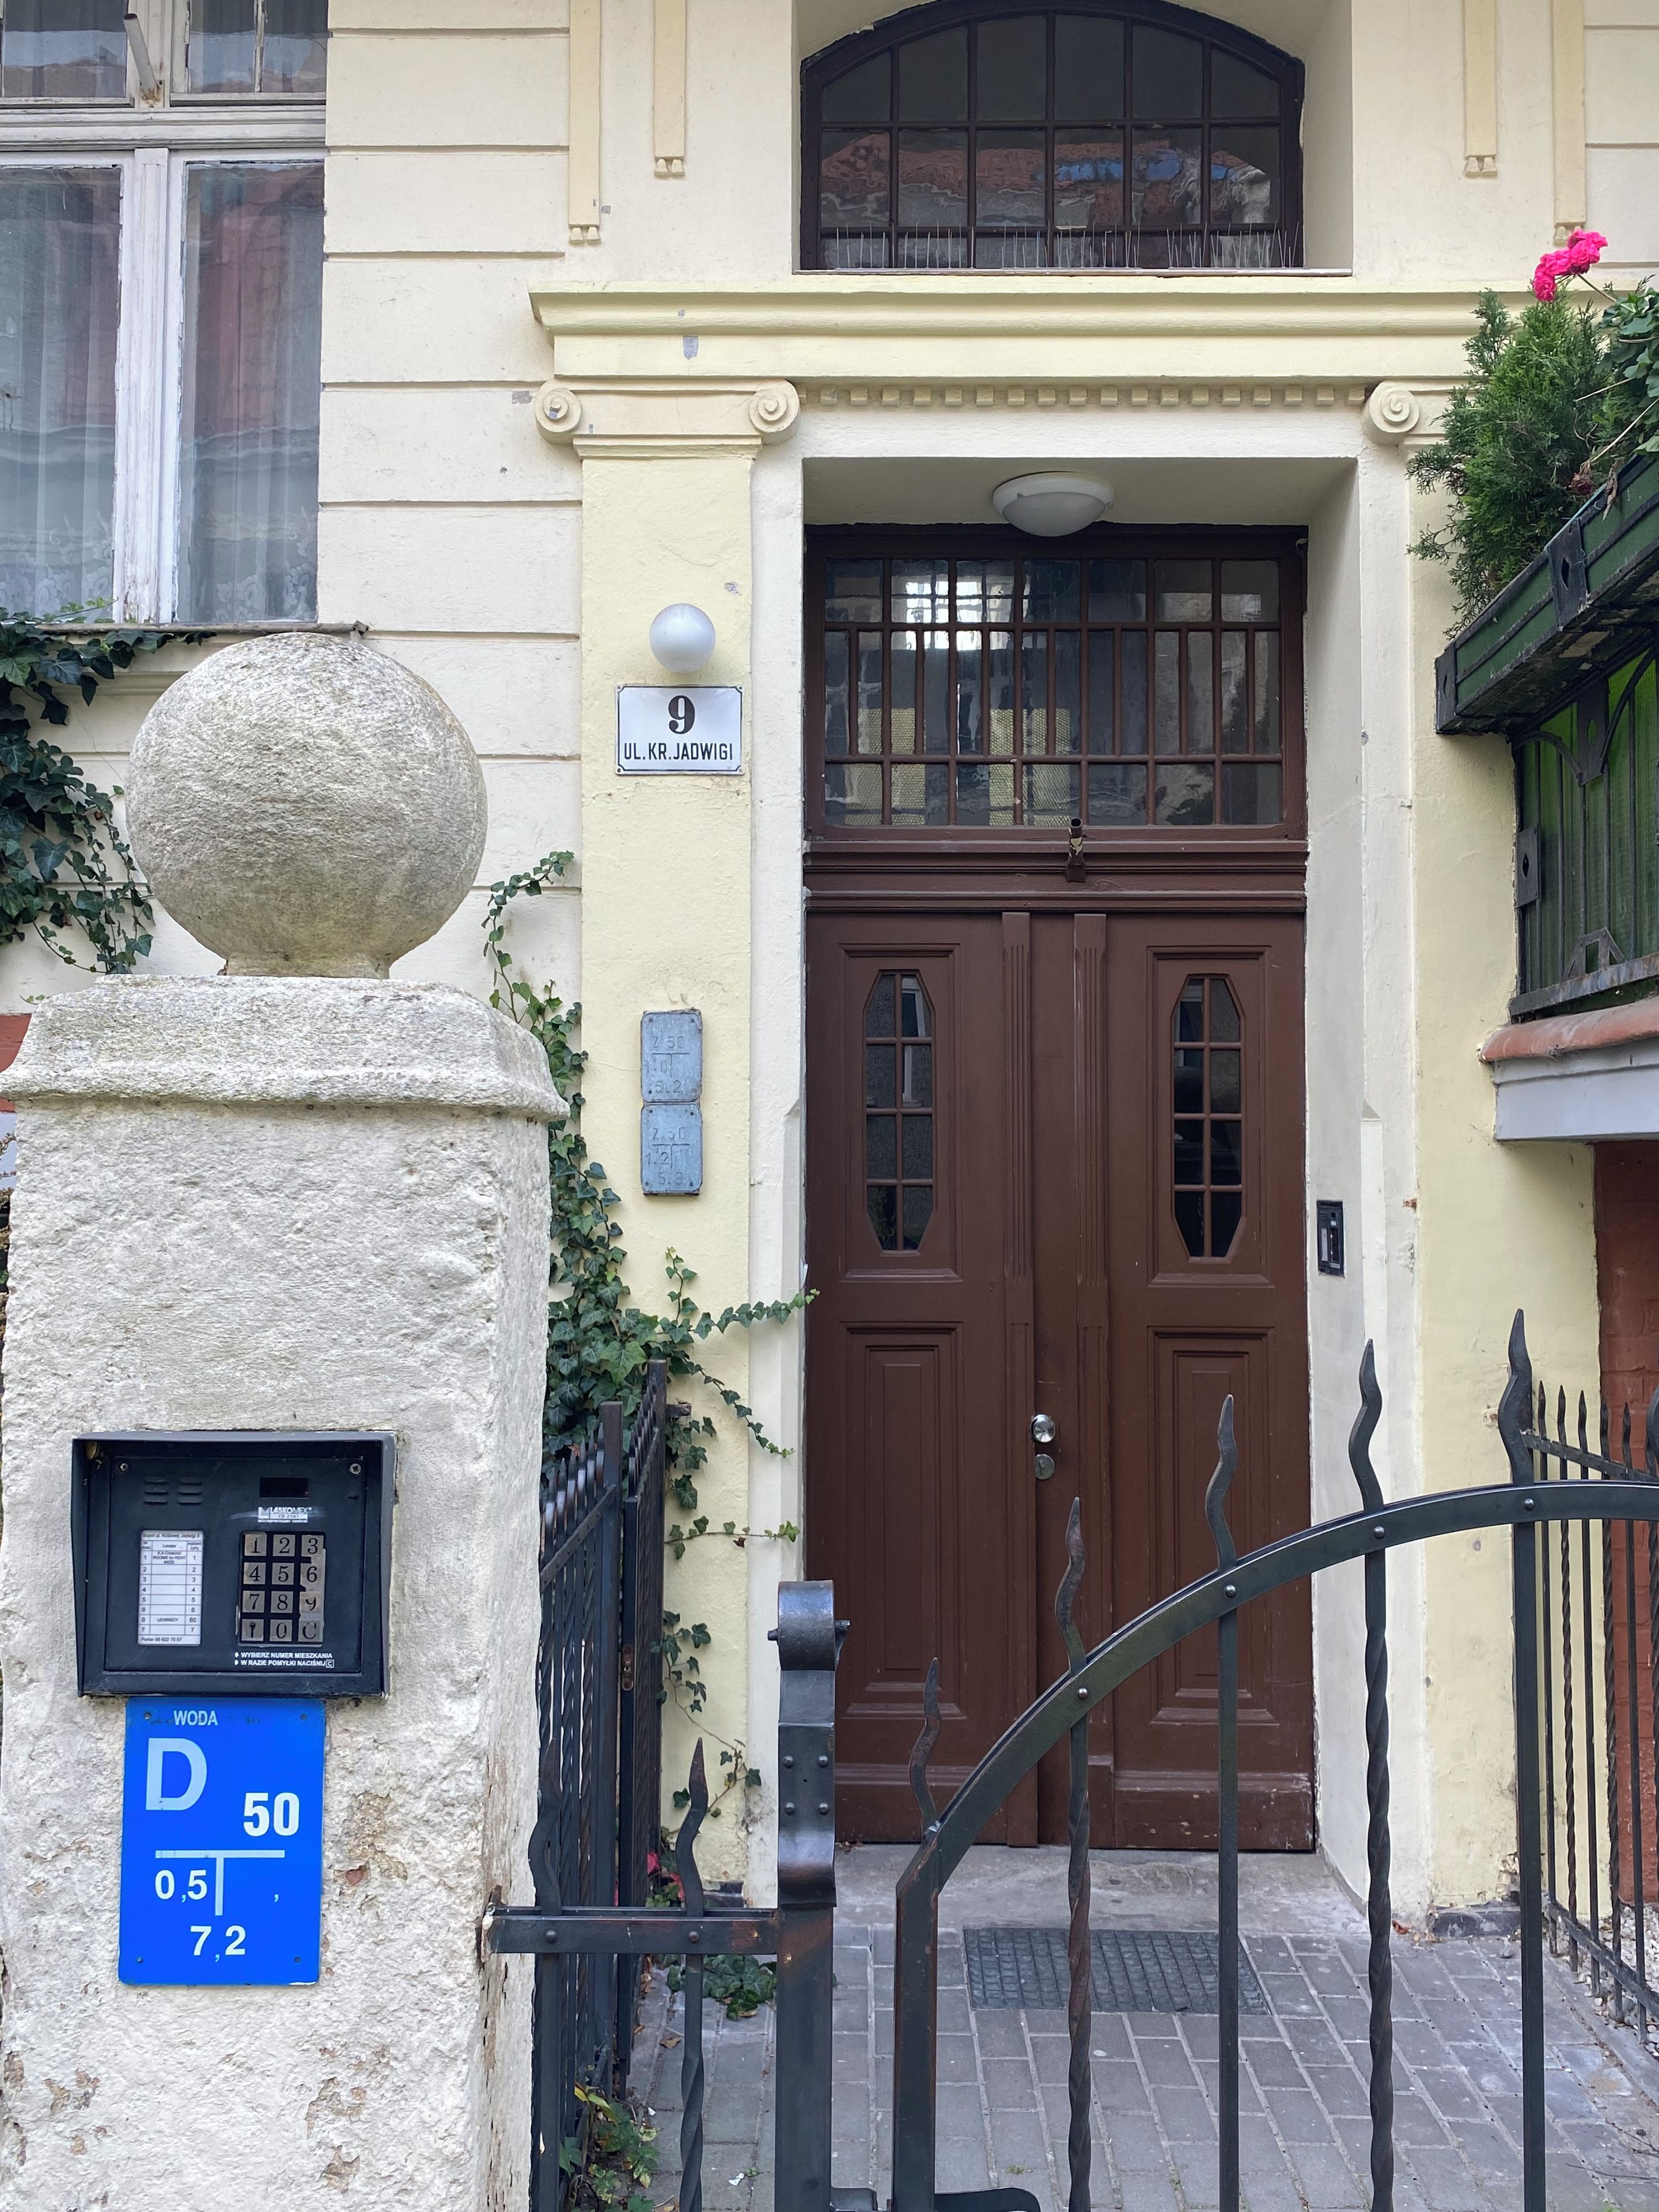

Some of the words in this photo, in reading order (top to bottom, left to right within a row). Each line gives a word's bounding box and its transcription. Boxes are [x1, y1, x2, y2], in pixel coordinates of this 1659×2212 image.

[668, 695, 695, 734] 9
[646, 1151, 669, 1166] 1.2
[251, 1537, 260, 1554] 1
[279, 1537, 290, 1554] 2
[307, 1537, 319, 1555] 3
[249, 1565, 261, 1582] 4
[278, 1566, 289, 1582] 5
[306, 1566, 317, 1583] 6
[249, 1593, 260, 1610] 7
[276, 1593, 288, 1611] 8
[276, 1622, 287, 1639] 0
[302, 1622, 317, 1639] C
[173, 1710, 218, 1726] WODA
[145, 1737, 208, 1811] D
[243, 1791, 300, 1837] 50
[154, 1869, 208, 1903] 0,5
[190, 1925, 247, 1963] 7,2
